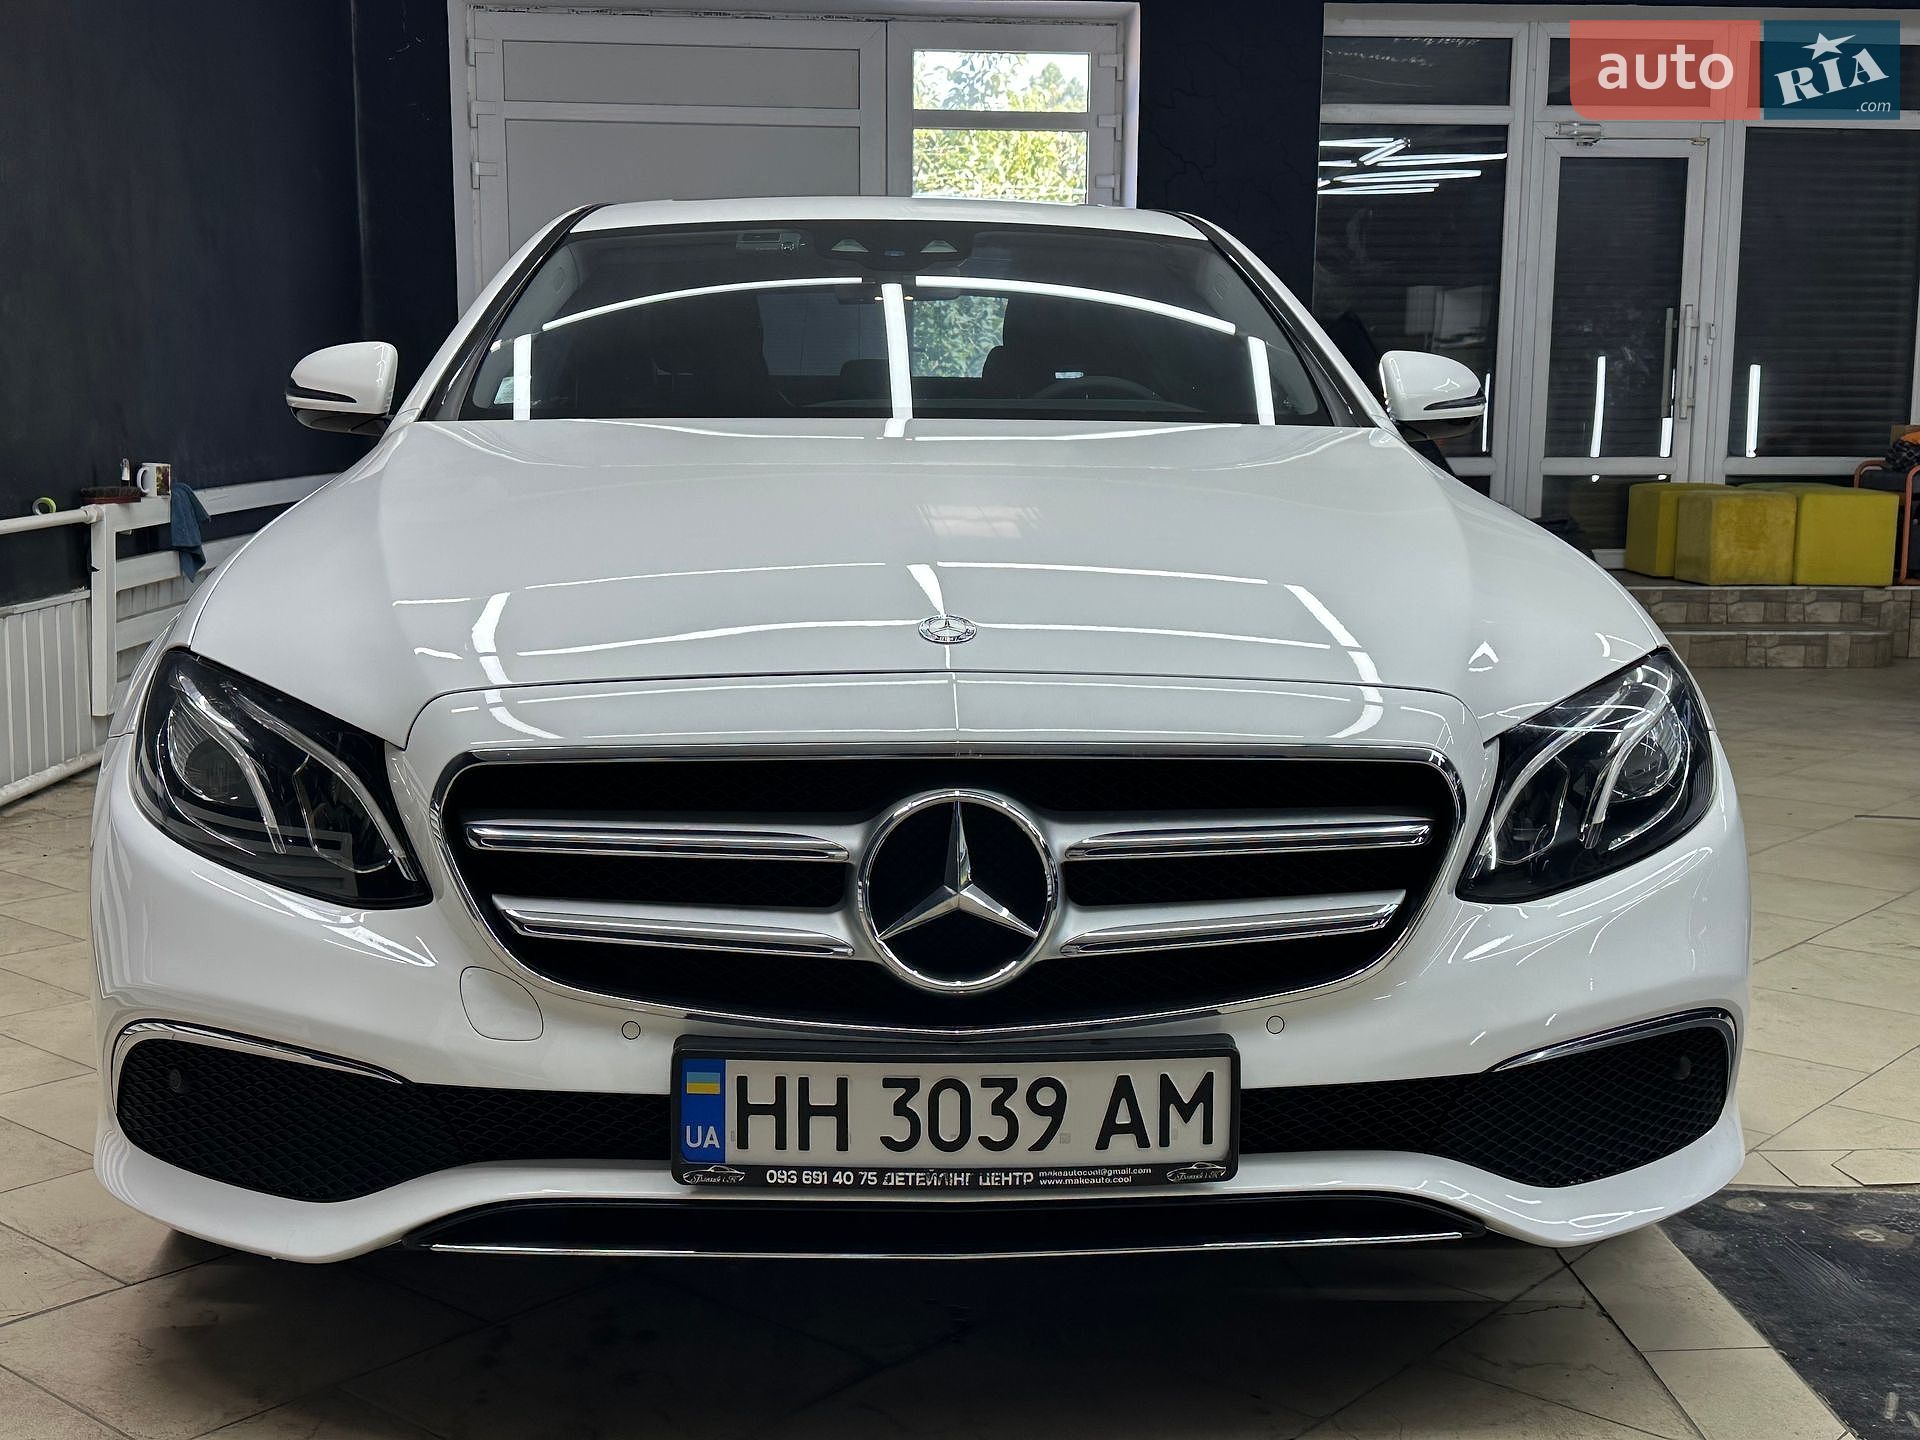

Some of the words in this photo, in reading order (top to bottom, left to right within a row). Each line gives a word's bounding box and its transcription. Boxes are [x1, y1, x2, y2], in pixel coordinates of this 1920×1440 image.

[736, 1075, 850, 1152] HH
[879, 1076, 1069, 1153] 3039
[1095, 1071, 1215, 1151] AM
[686, 1125, 721, 1149] UA
[766, 1169, 798, 1185] 093
[802, 1170, 828, 1185] 691
[832, 1171, 854, 1185] 40
[857, 1171, 878, 1186] 75
[978, 1171, 1034, 1187] ЦЕНТР
